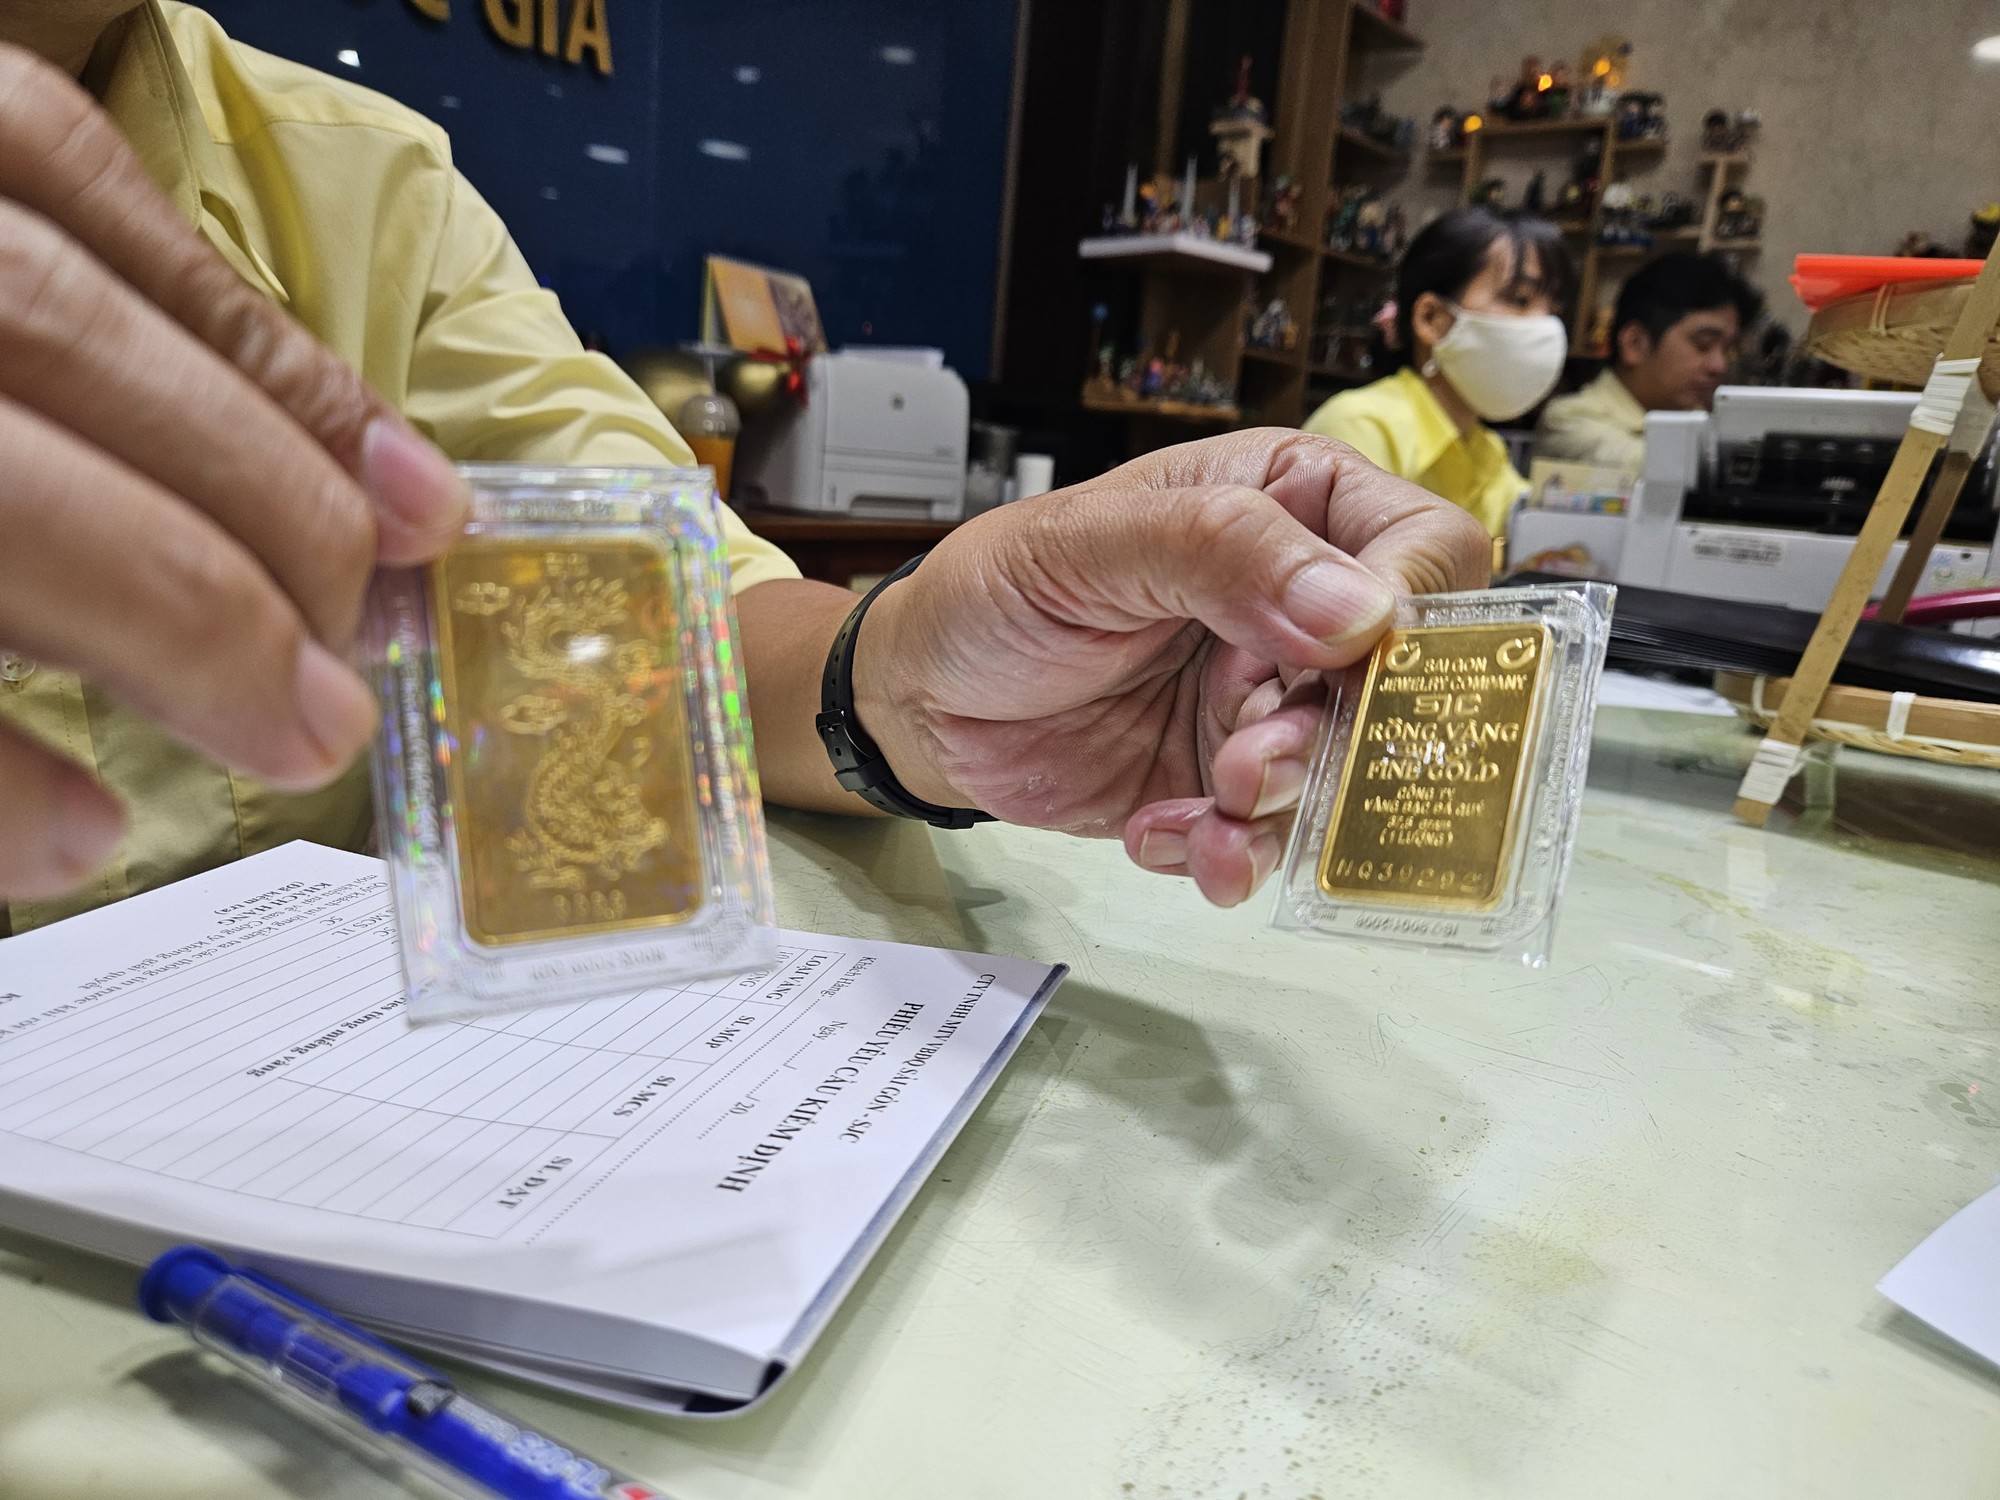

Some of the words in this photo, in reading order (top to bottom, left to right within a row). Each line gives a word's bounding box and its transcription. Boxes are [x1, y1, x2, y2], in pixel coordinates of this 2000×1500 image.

[1379, 675, 1449, 693] JEWELRY
[1450, 674, 1528, 691] COMPANY
[1413, 693, 1482, 722] SJC
[1366, 758, 1421, 781] FINE
[1427, 760, 1500, 782] GOLD
[270, 882, 334, 906] KHÁCH
[217, 904, 273, 926] HÀNG
[794, 954, 829, 977] LOẠI
[844, 955, 878, 978] Khách
[765, 975, 805, 1001] VÀNG
[972, 973, 997, 992] CTY
[949, 992, 984, 1019] TNHH
[875, 1001, 926, 1040] PHIẾU
[932, 1019, 963, 1042] MTV
[290, 1028, 345, 1055] miếng
[847, 1040, 890, 1066] YÊU
[246, 1055, 297, 1078] vàng
[890, 1066, 919, 1086] SÀI
[815, 1066, 859, 1097] CẦU
[612, 1089, 659, 1118] MCS
[865, 1086, 901, 1113] GÒN
[767, 1097, 831, 1141] KIỂM
[838, 1119, 873, 1144] SJC
[715, 1143, 784, 1192] ĐỊNH
[496, 1176, 550, 1210] ĐẠT
